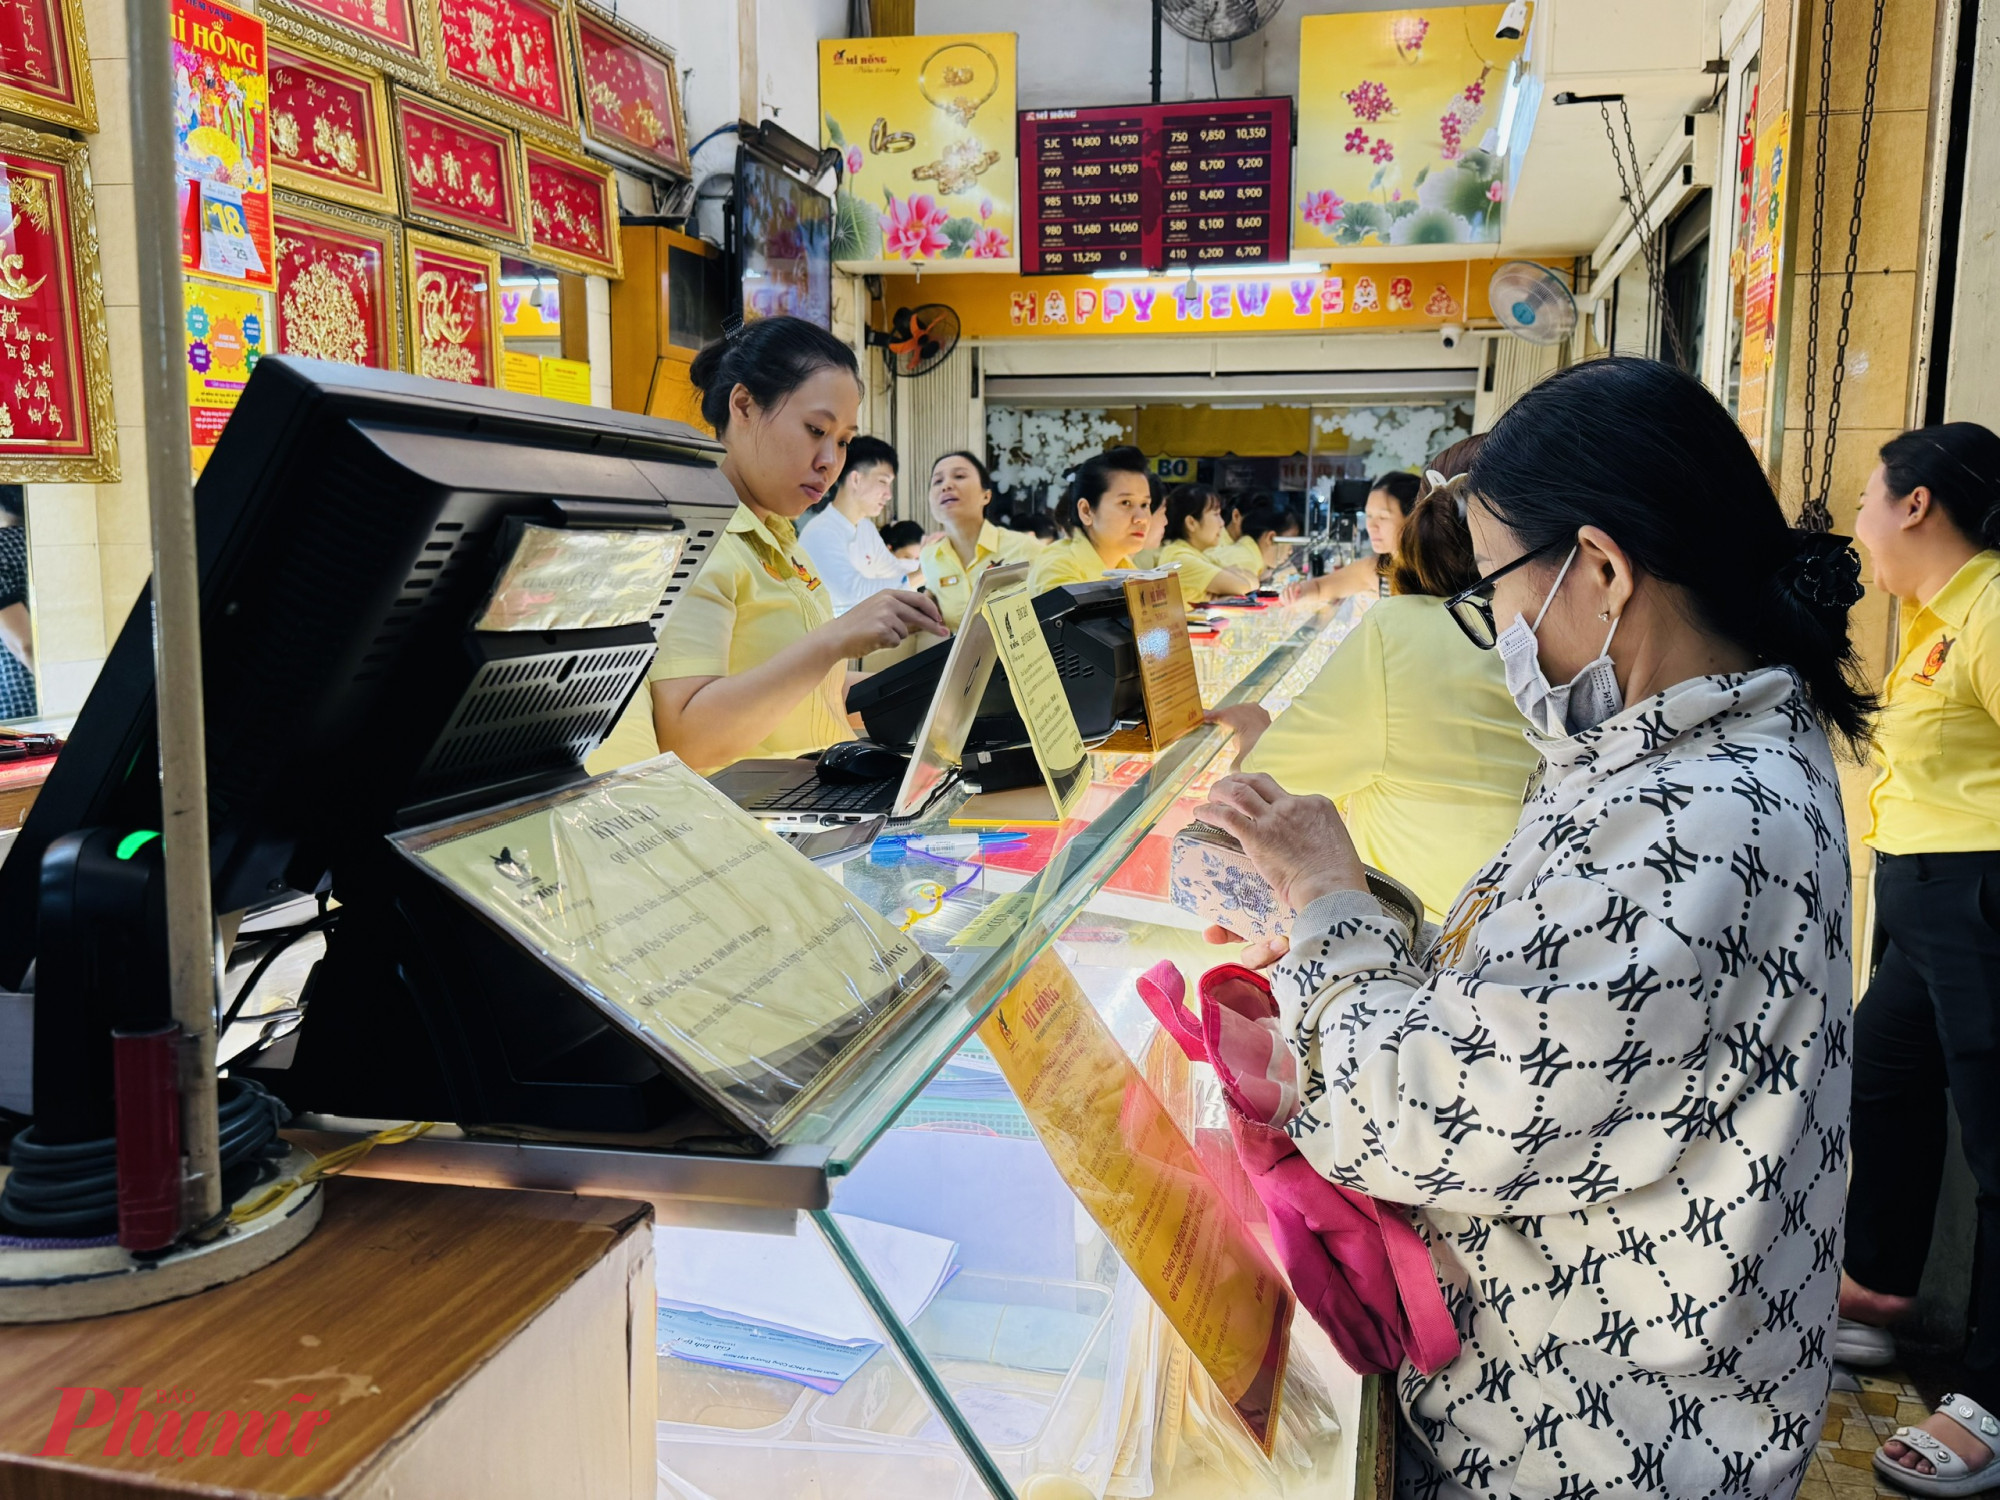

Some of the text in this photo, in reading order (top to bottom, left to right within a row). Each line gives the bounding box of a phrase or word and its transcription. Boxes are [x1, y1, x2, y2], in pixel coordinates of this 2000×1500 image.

[1044, 134, 1139, 150] SJC 14,800 14,930
[1170, 127, 1266, 143] 750 9,850 10,350
[1044, 163, 1139, 178] 999 14,800 14,930
[1170, 157, 1263, 172] 680 8,700 9,200
[1044, 192, 1139, 207] 985 13,730 14,130
[1170, 187, 1263, 202] 610 8,400 8,900
[211, 203, 245, 239] 18
[1169, 216, 1262, 231] 580 8,100 8,600
[1045, 222, 1139, 236] 980 13,680 14,060
[1045, 251, 1127, 264] 950 13,250 0
[1169, 246, 1261, 260] 410 6,200 6,700
[1011, 277, 1413, 325] HAPPY NEW YEAR
[1644, 836, 1698, 884] NY
[1607, 964, 1661, 1012] NY
[1520, 1038, 1572, 1088] NY
[1681, 1197, 1726, 1246] NY
